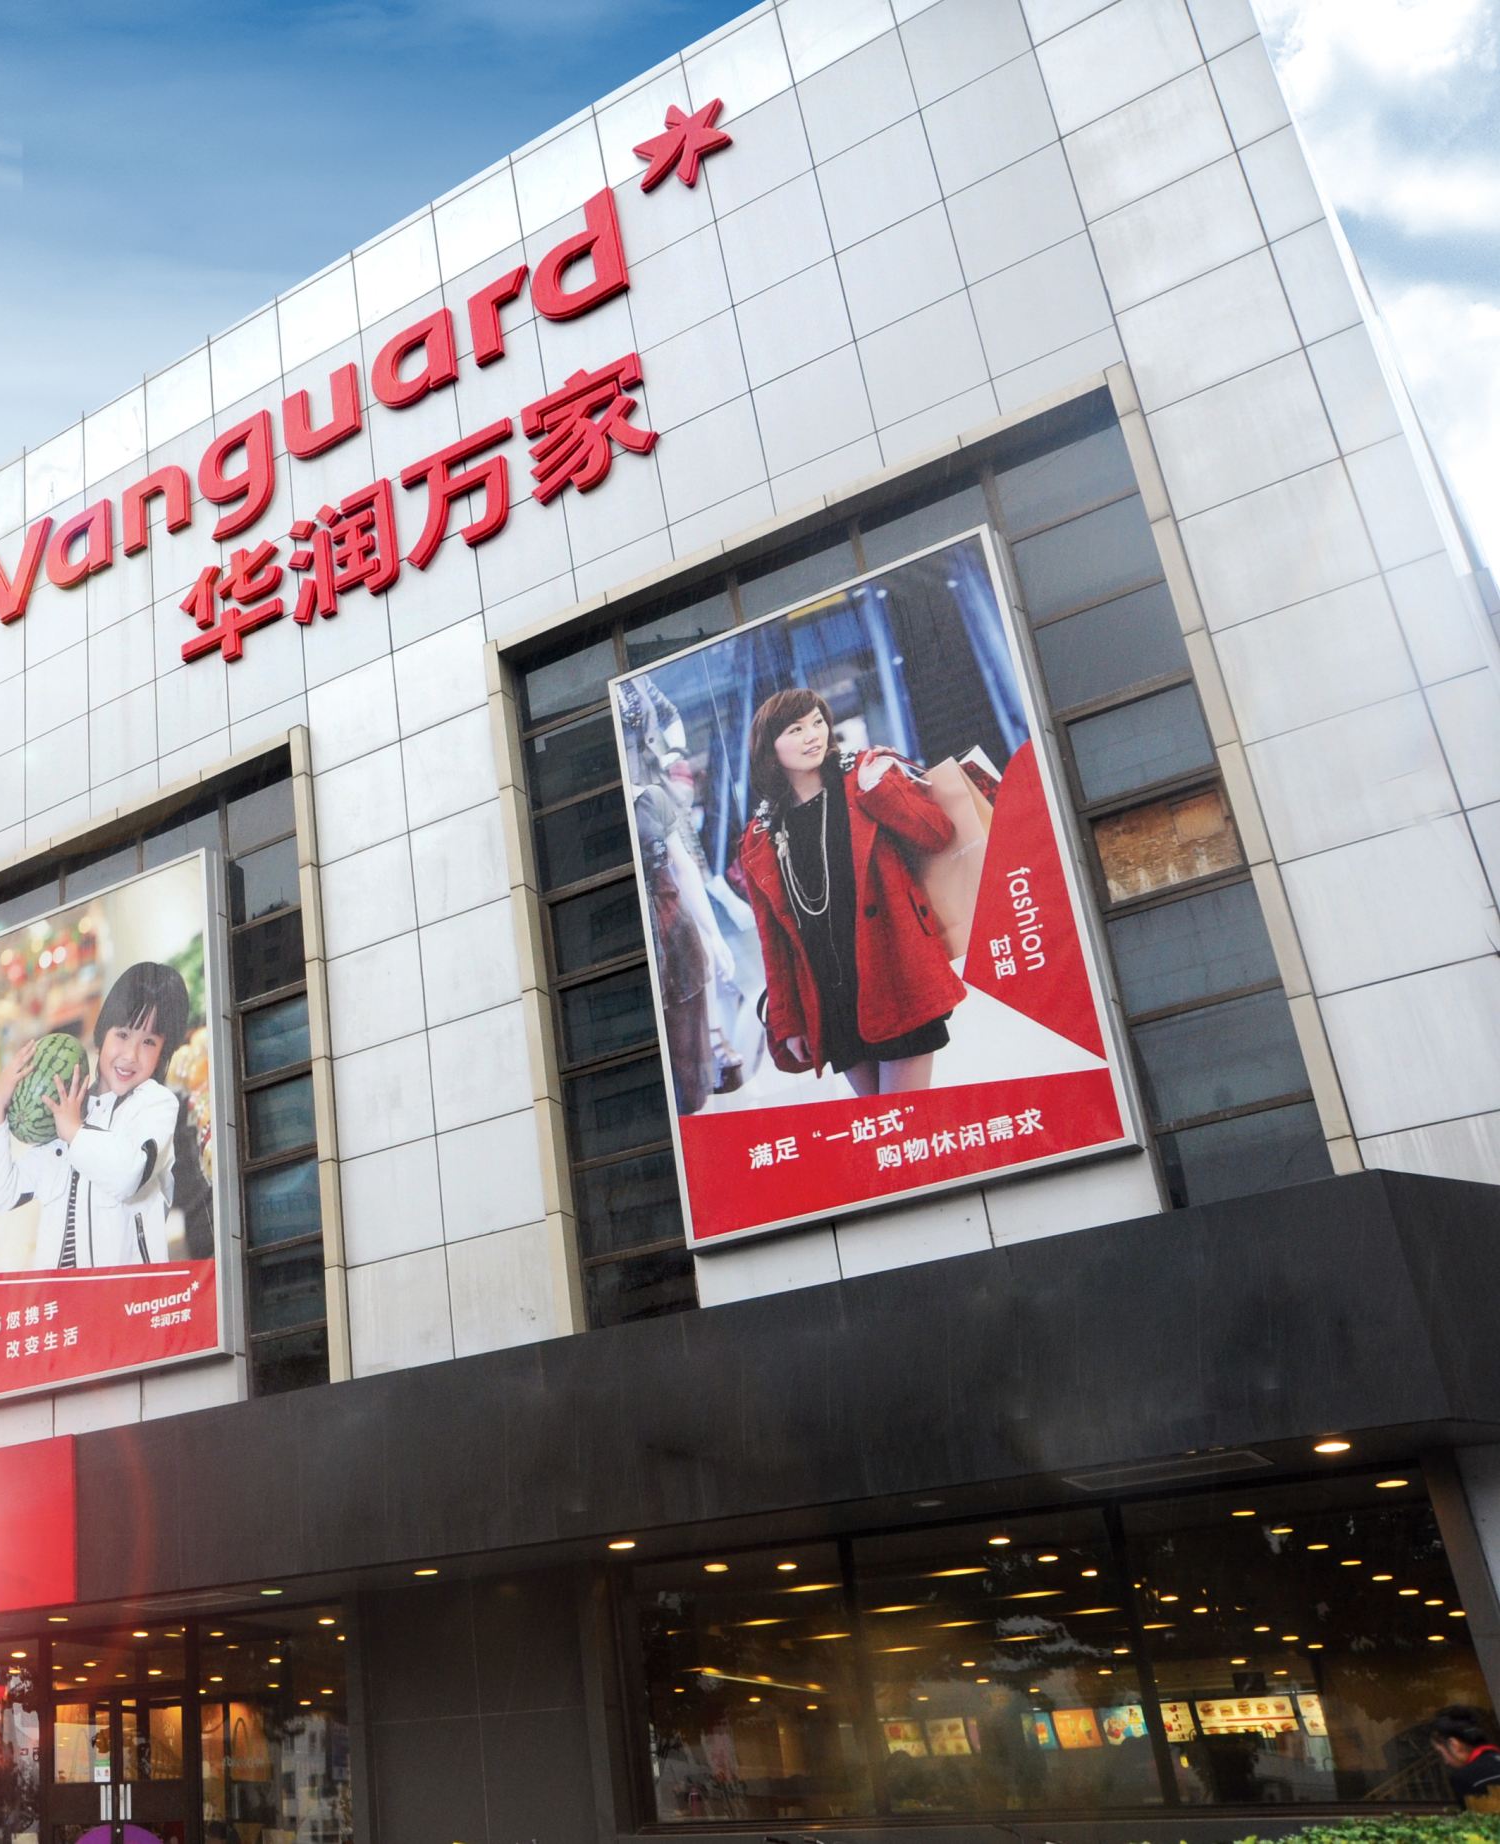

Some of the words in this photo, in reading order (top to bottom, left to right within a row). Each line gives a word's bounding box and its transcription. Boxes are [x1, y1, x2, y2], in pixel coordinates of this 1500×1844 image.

[180, 352, 660, 664] 华润万家
[1006, 866, 1045, 971] fashion
[989, 934, 1017, 980] 时尚
[748, 1135, 800, 1171] 满足
[876, 1108, 1044, 1172] 购物休闲需求
[124, 1287, 192, 1317] Vanguard
[150, 1308, 192, 1329] 华润万家
[5, 1327, 79, 1360] 改变生活
